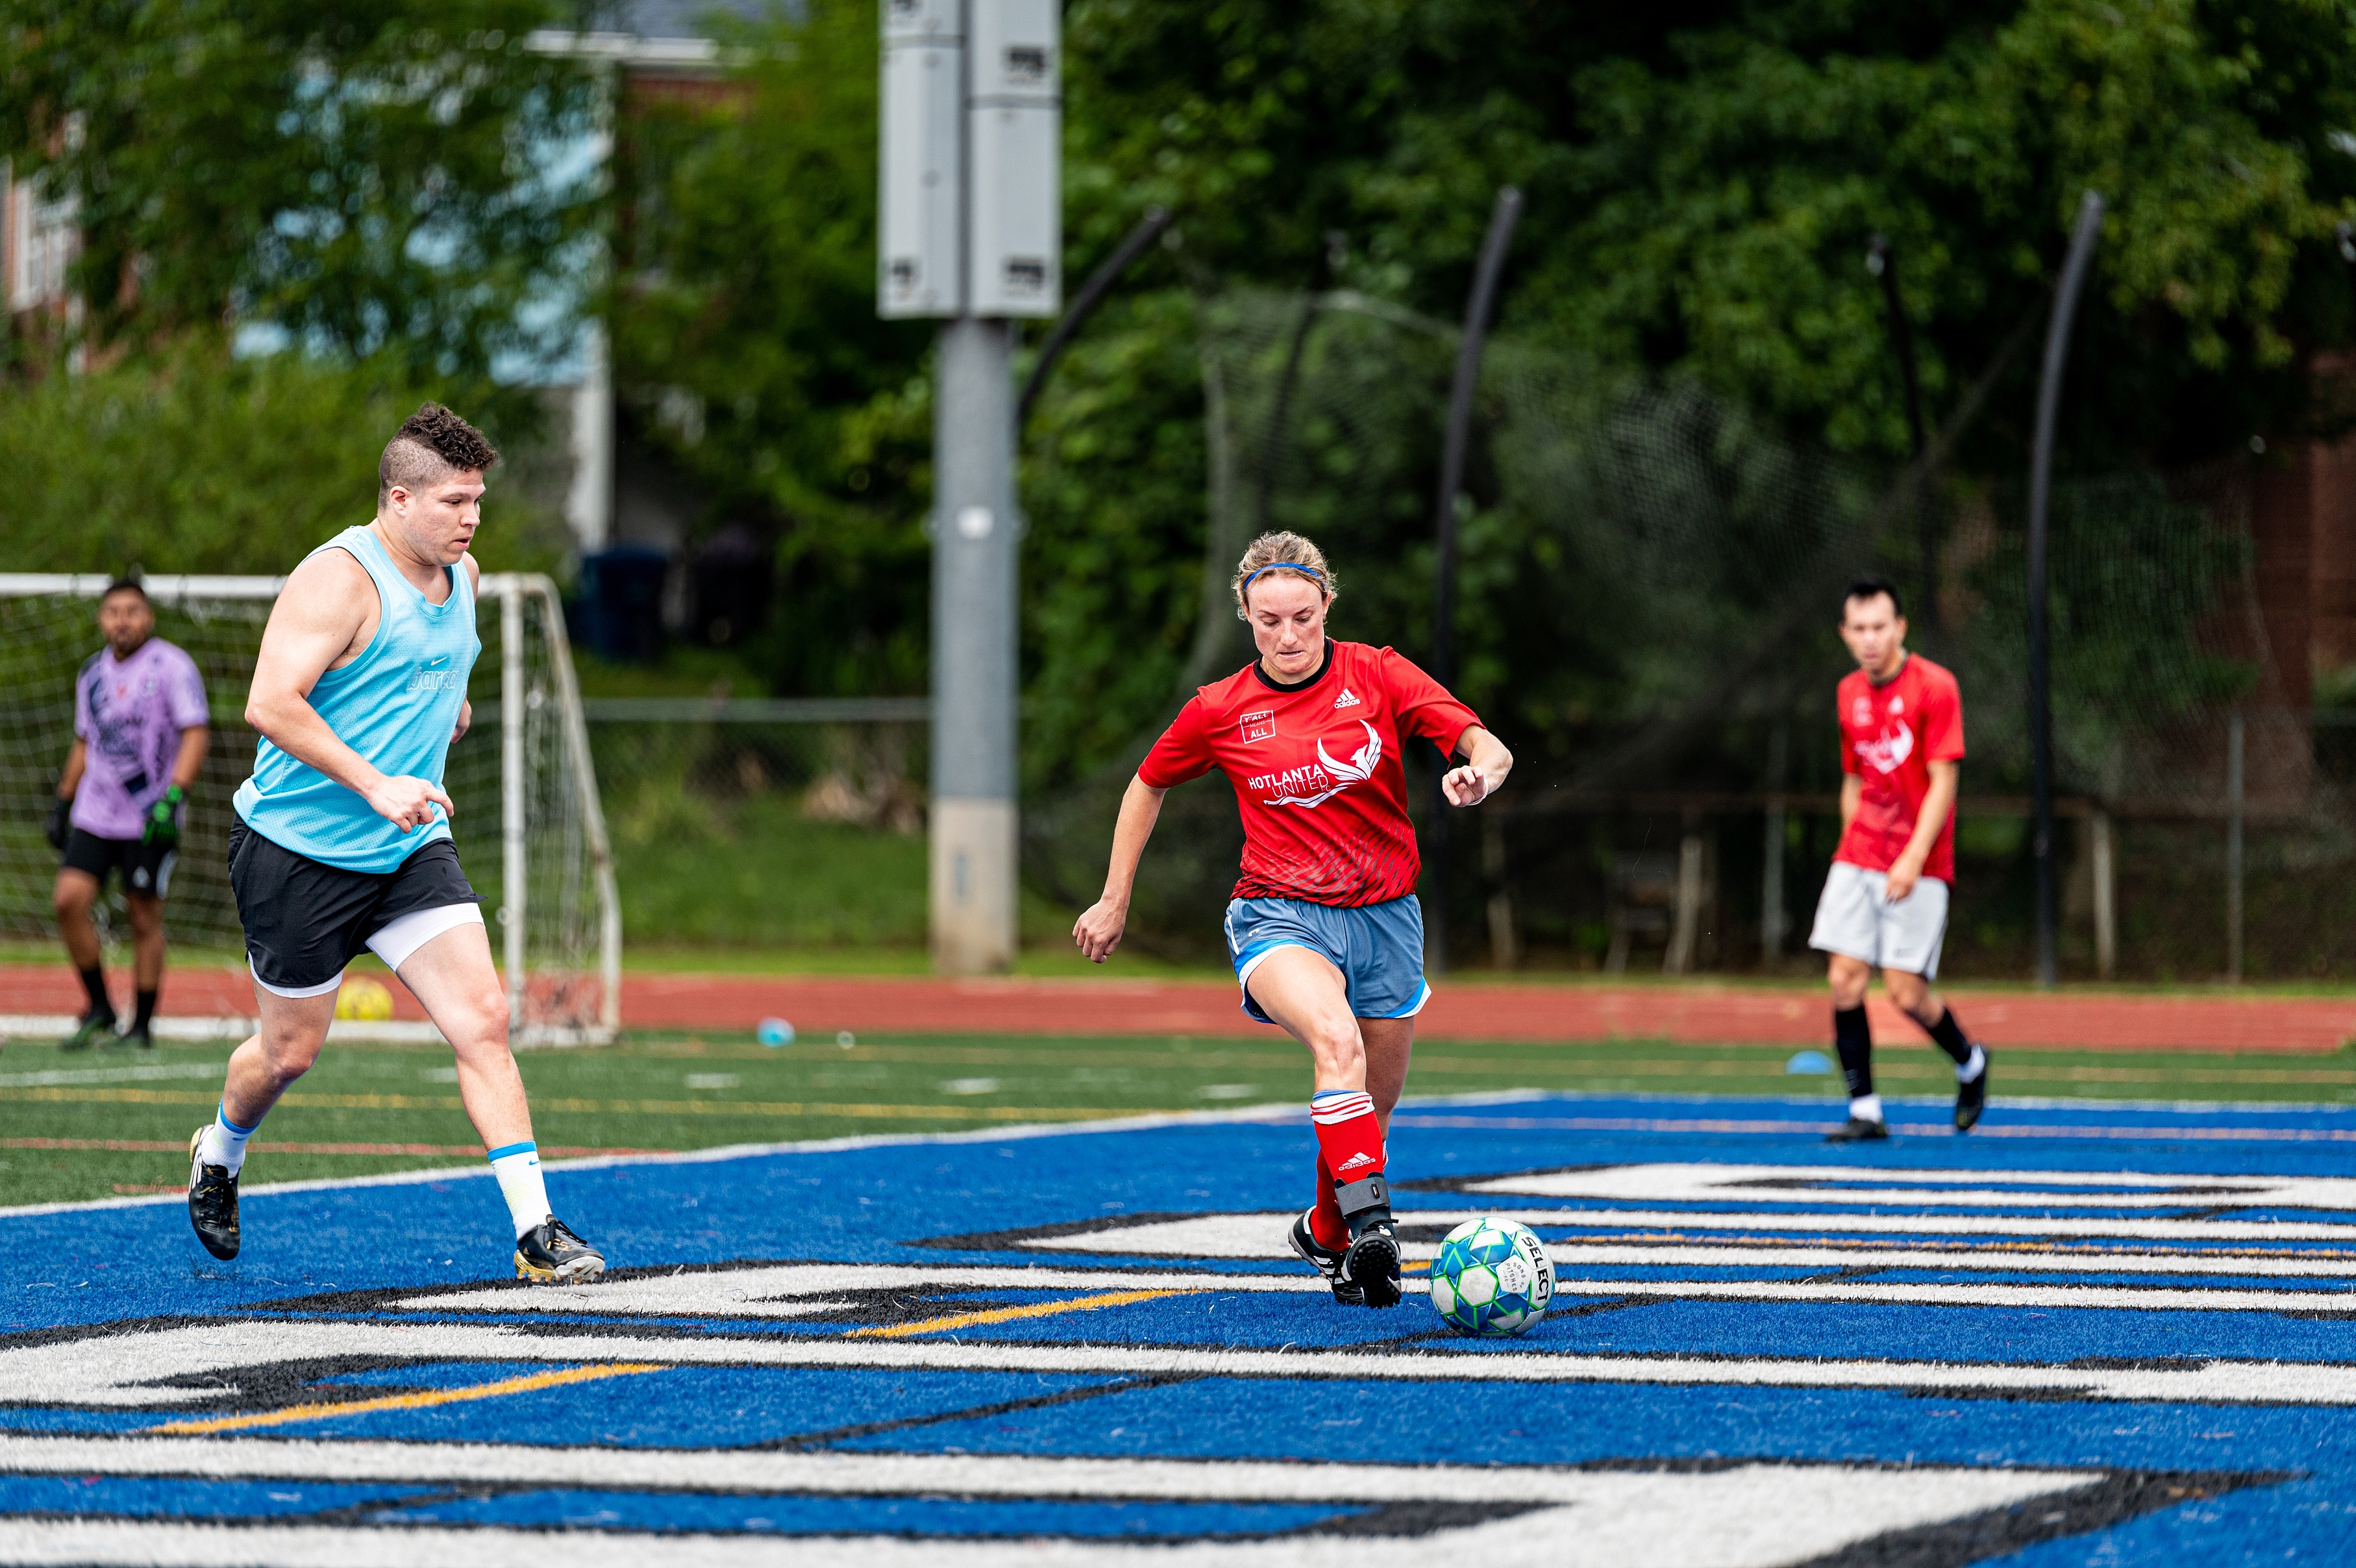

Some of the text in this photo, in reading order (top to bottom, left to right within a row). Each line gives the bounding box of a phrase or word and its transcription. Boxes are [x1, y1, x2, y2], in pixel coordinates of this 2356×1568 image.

[1334, 698, 1361, 709] adidas
[1250, 728, 1267, 739] ALL
[1247, 764, 1324, 790] HOTLANTA
[1272, 775, 1328, 798] UNITED
[1338, 1158, 1376, 1171] adidas
[1506, 1262, 1518, 1292] PITCHES
[1513, 1262, 1526, 1278] SONS
[1521, 1236, 1549, 1301] SELECT
